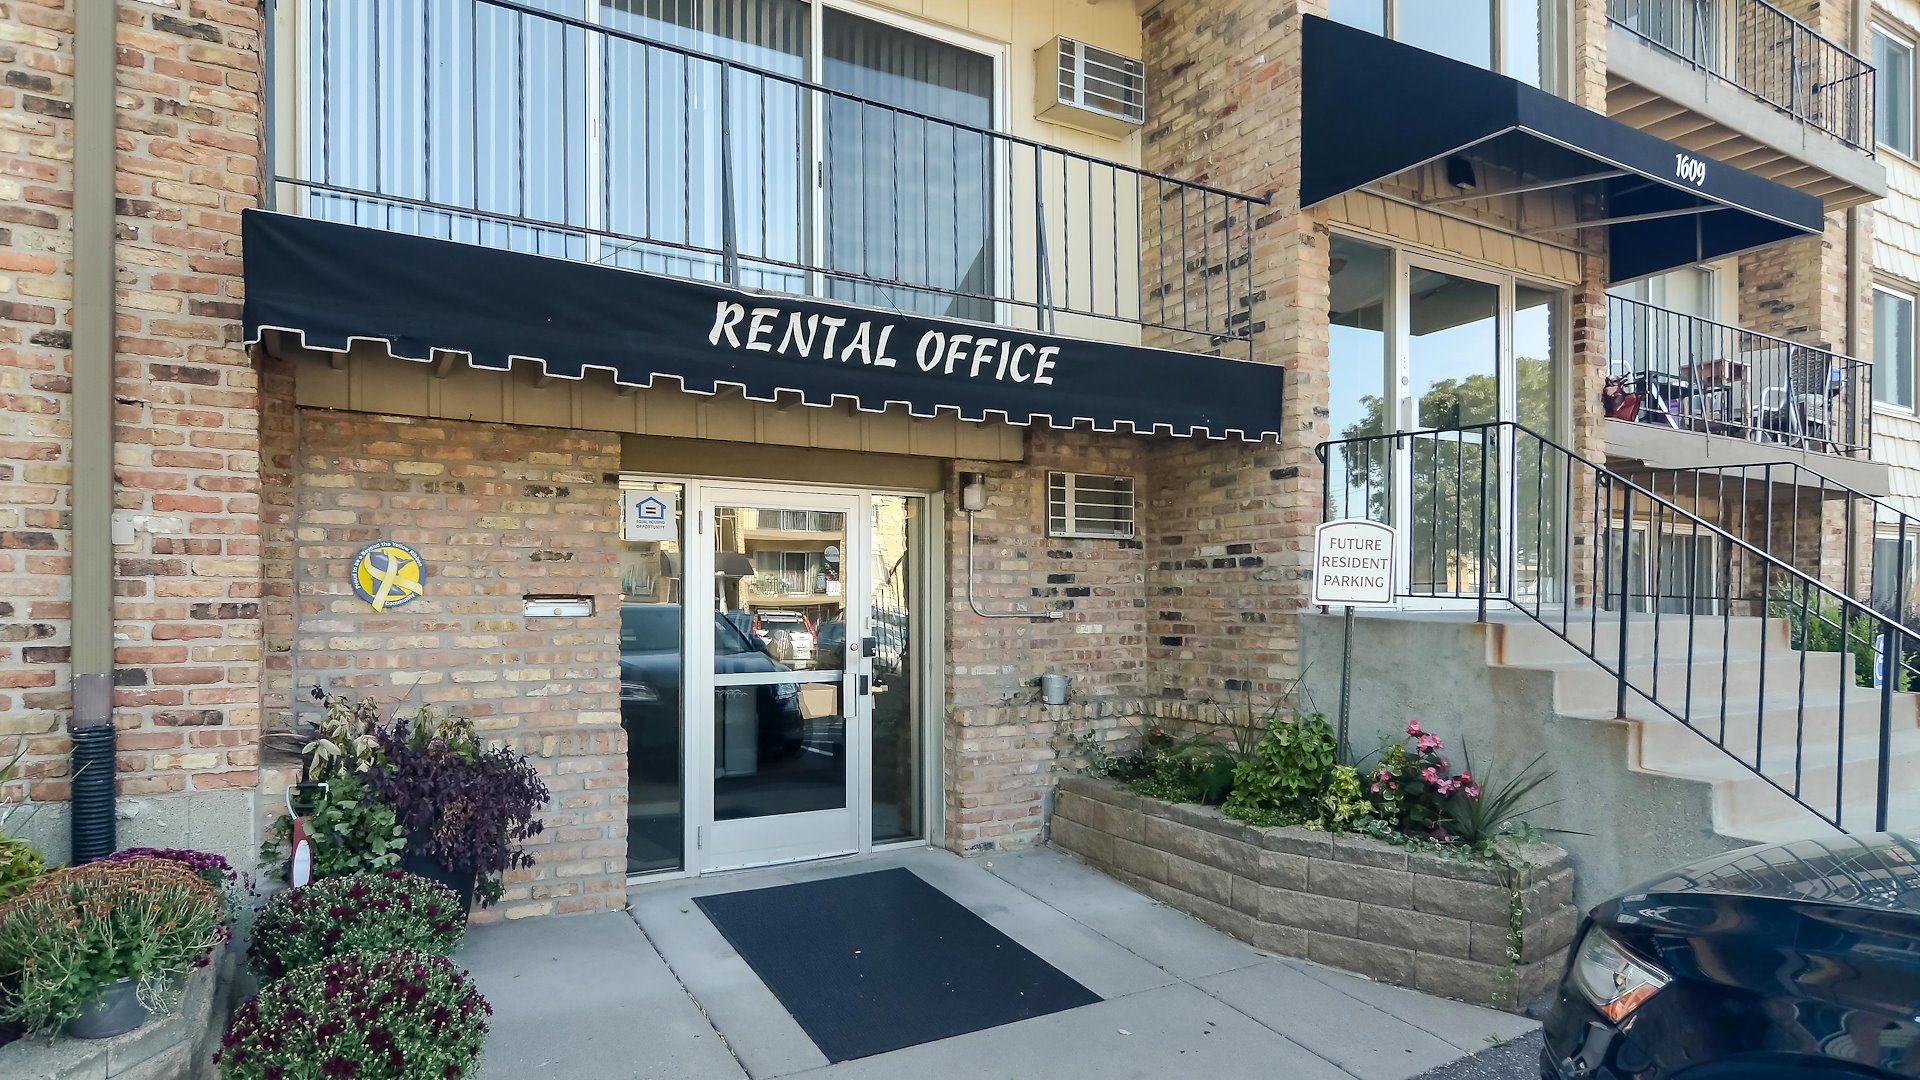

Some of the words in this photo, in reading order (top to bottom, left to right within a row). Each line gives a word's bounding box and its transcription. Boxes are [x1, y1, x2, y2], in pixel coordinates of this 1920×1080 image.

[1675, 153, 1706, 187] 1609
[708, 301, 897, 368] RENTAL
[916, 329, 1061, 385] OFFICE
[1330, 537, 1382, 551] FUTURE
[352, 573, 361, 590] Proud
[360, 543, 381, 556] Beyond
[392, 541, 410, 552] Yellow
[409, 549, 423, 567] Ribbon
[1321, 556, 1389, 570] RESIDENT
[1323, 574, 1384, 588] PARKING
[384, 593, 416, 606] Community
